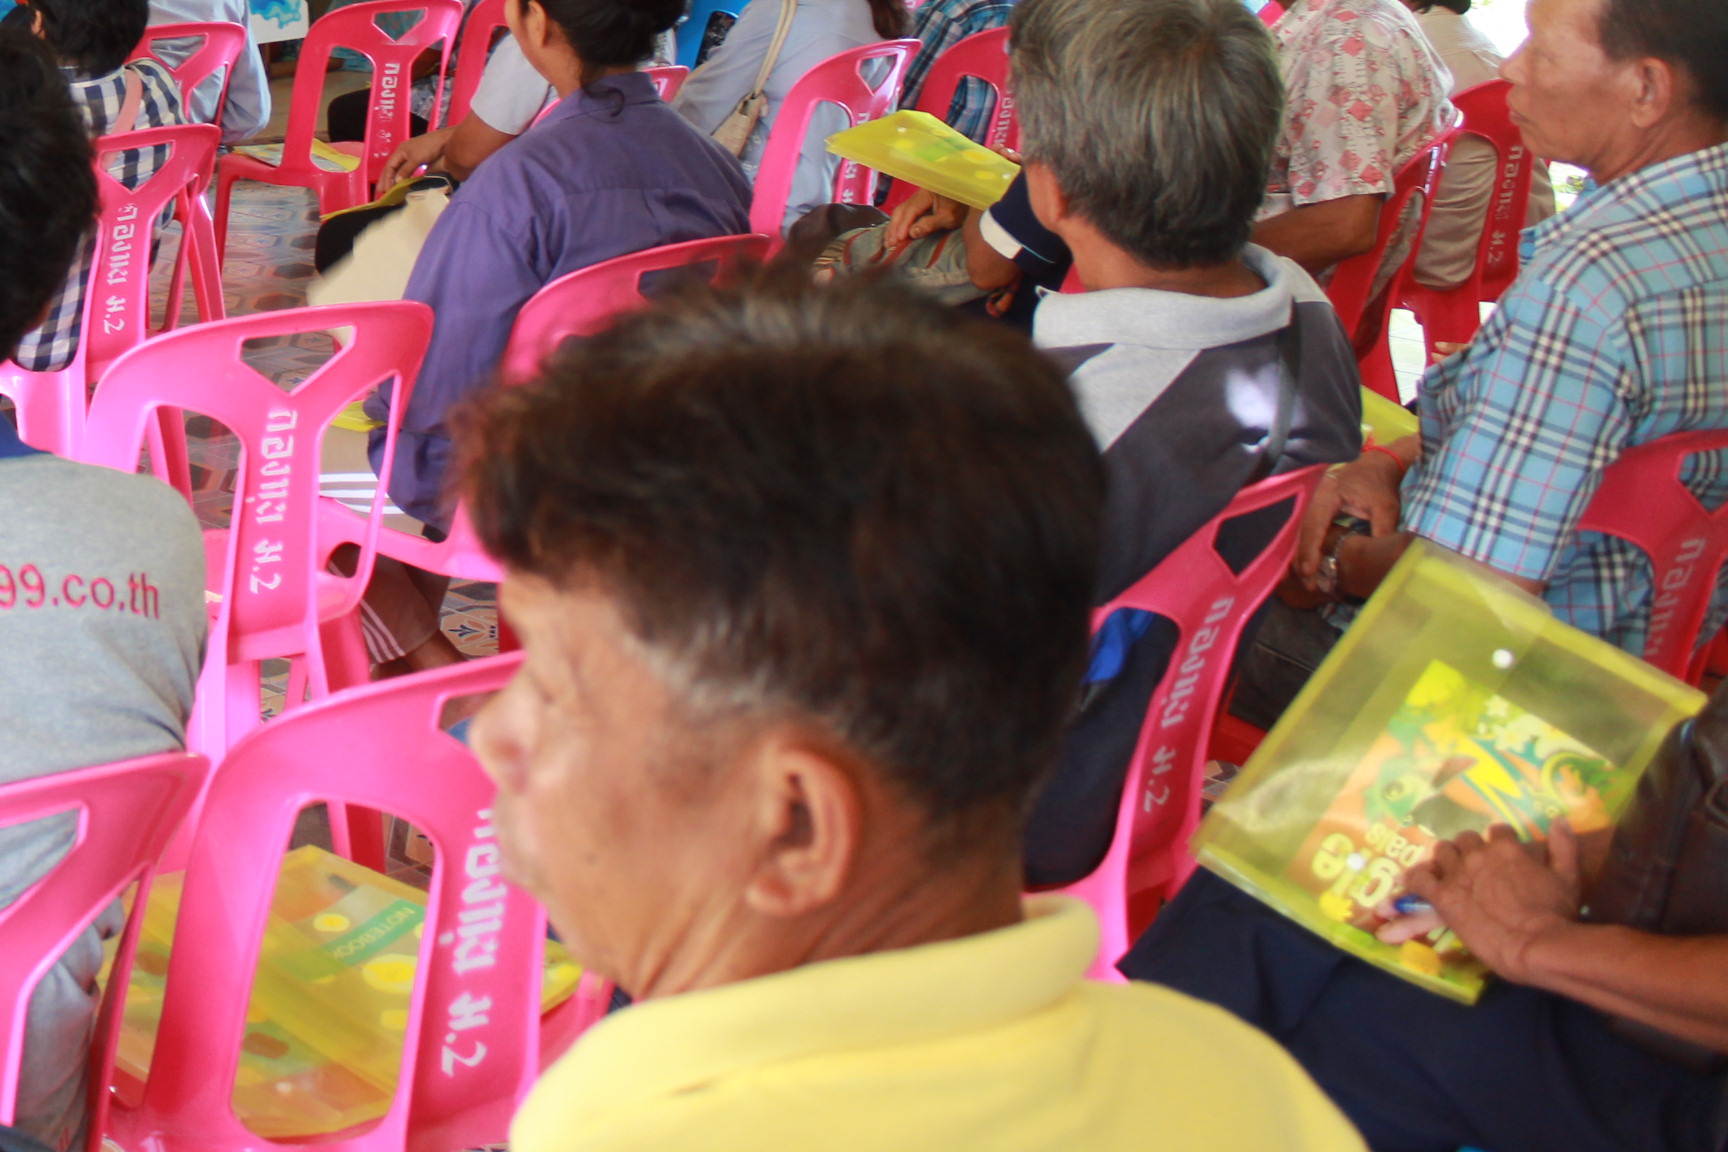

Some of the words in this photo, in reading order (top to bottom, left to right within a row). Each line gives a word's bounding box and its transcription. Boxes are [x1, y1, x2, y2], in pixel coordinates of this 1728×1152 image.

[103, 295, 127, 334] ม.2
[249, 539, 284, 595] ม.2
[333, 906, 416, 959] NOTEBOOK
[440, 993, 492, 1078] ม.2
